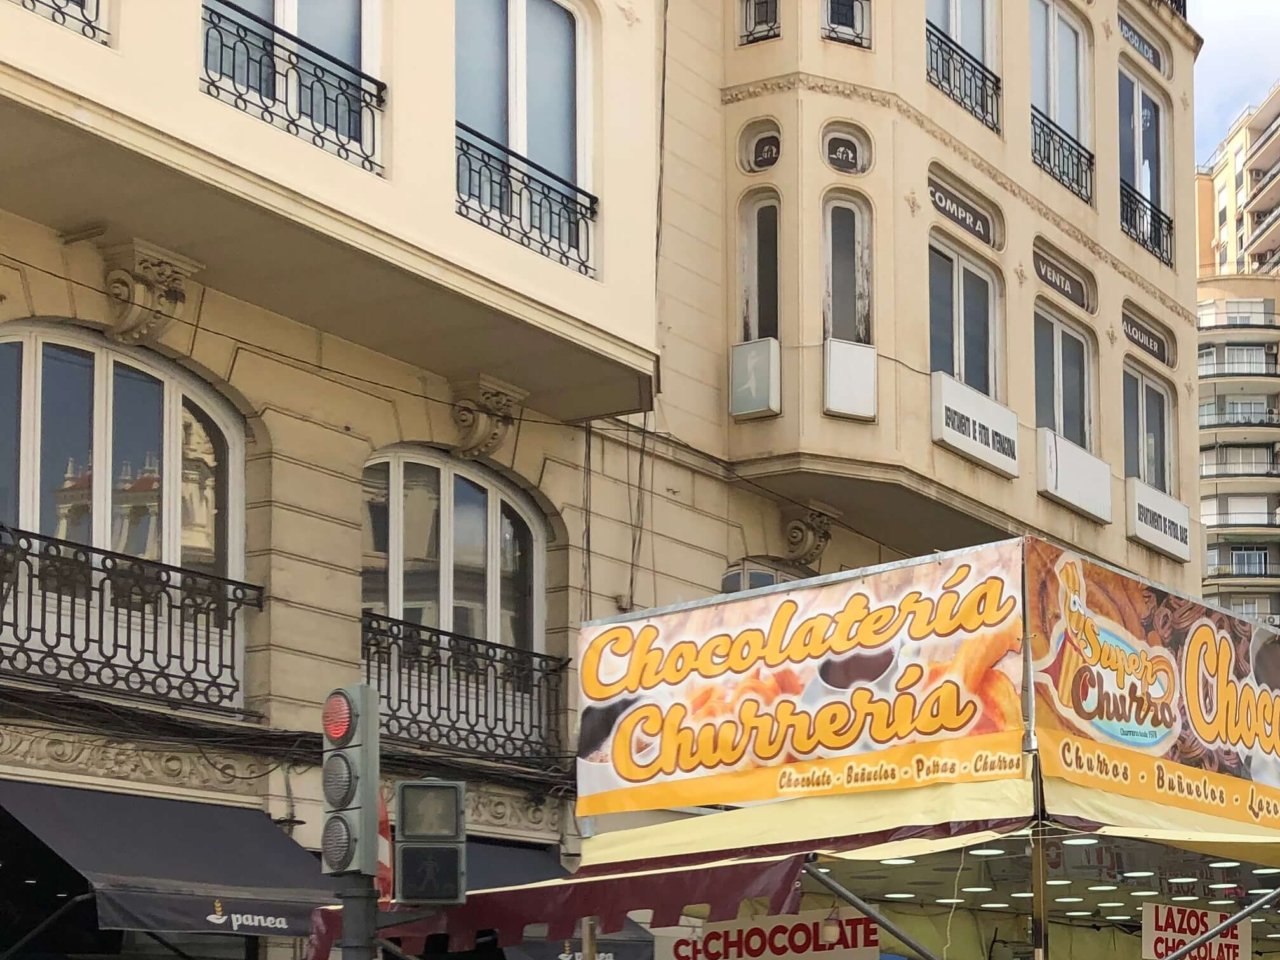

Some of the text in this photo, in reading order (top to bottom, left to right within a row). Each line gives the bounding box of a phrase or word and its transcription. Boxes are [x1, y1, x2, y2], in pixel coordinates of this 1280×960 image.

[1039, 263, 1072, 295] VENTA
[1122, 320, 1159, 353] ALQUILER
[581, 564, 1016, 700] Chocolatería
[1080, 617, 1158, 689] Super
[1071, 665, 1177, 728] Churro
[612, 664, 977, 783] Churrería
[779, 771, 832, 789] Chocolate
[846, 765, 896, 785] Buñuelos
[974, 753, 1021, 773] Churros
[1061, 741, 1129, 781] Churros
[1156, 763, 1225, 805] Buñuelos
[231, 913, 288, 931] panea
[1155, 905, 1209, 936] LAZOS
